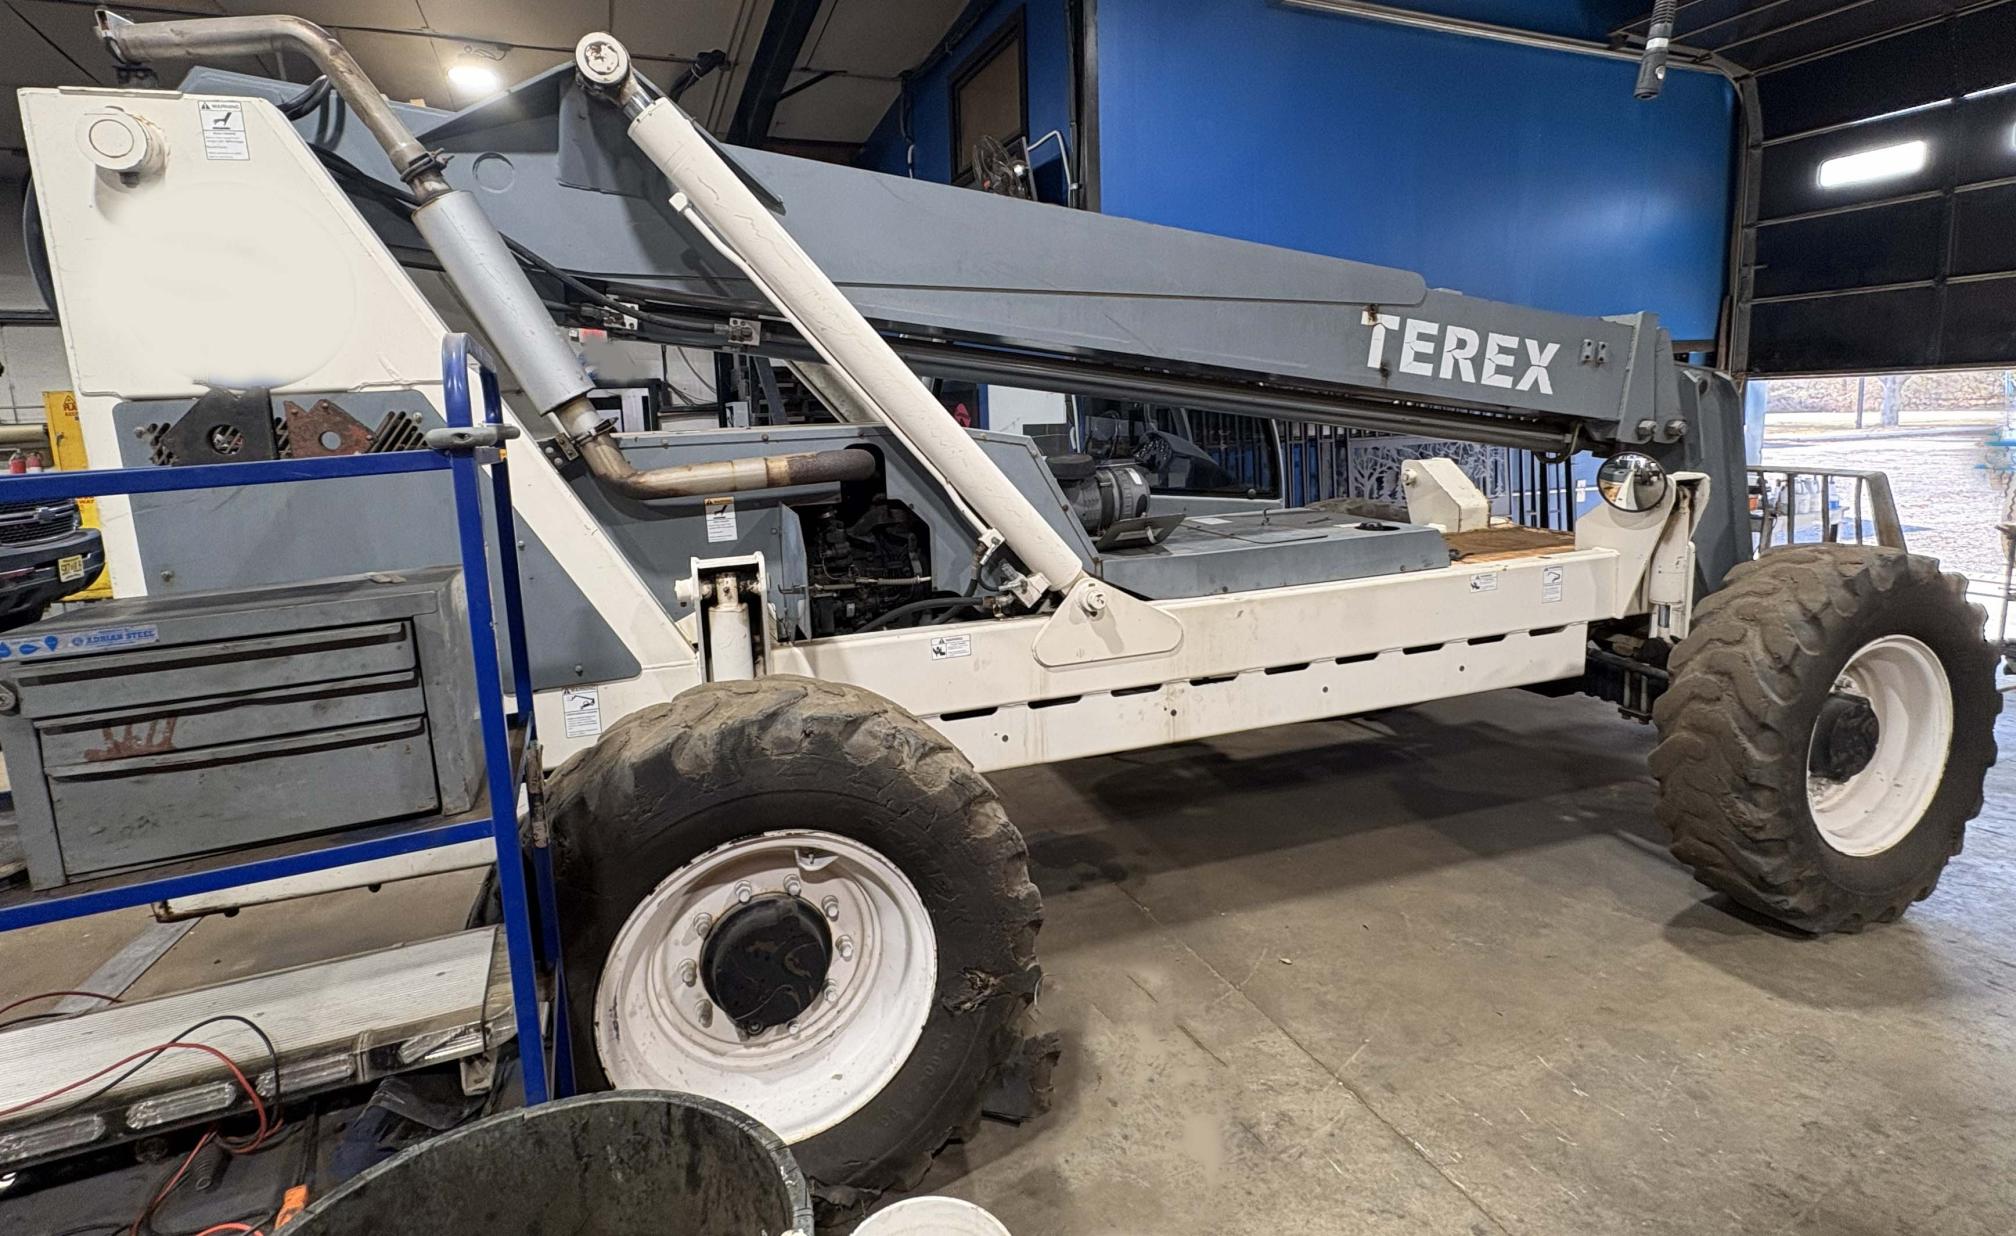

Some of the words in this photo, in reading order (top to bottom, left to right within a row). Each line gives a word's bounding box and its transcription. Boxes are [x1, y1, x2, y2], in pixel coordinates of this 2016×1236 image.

[1360, 310, 1561, 395] TEREX
[86, 633, 123, 644] ADRIAN
[127, 630, 155, 640] STEEL
